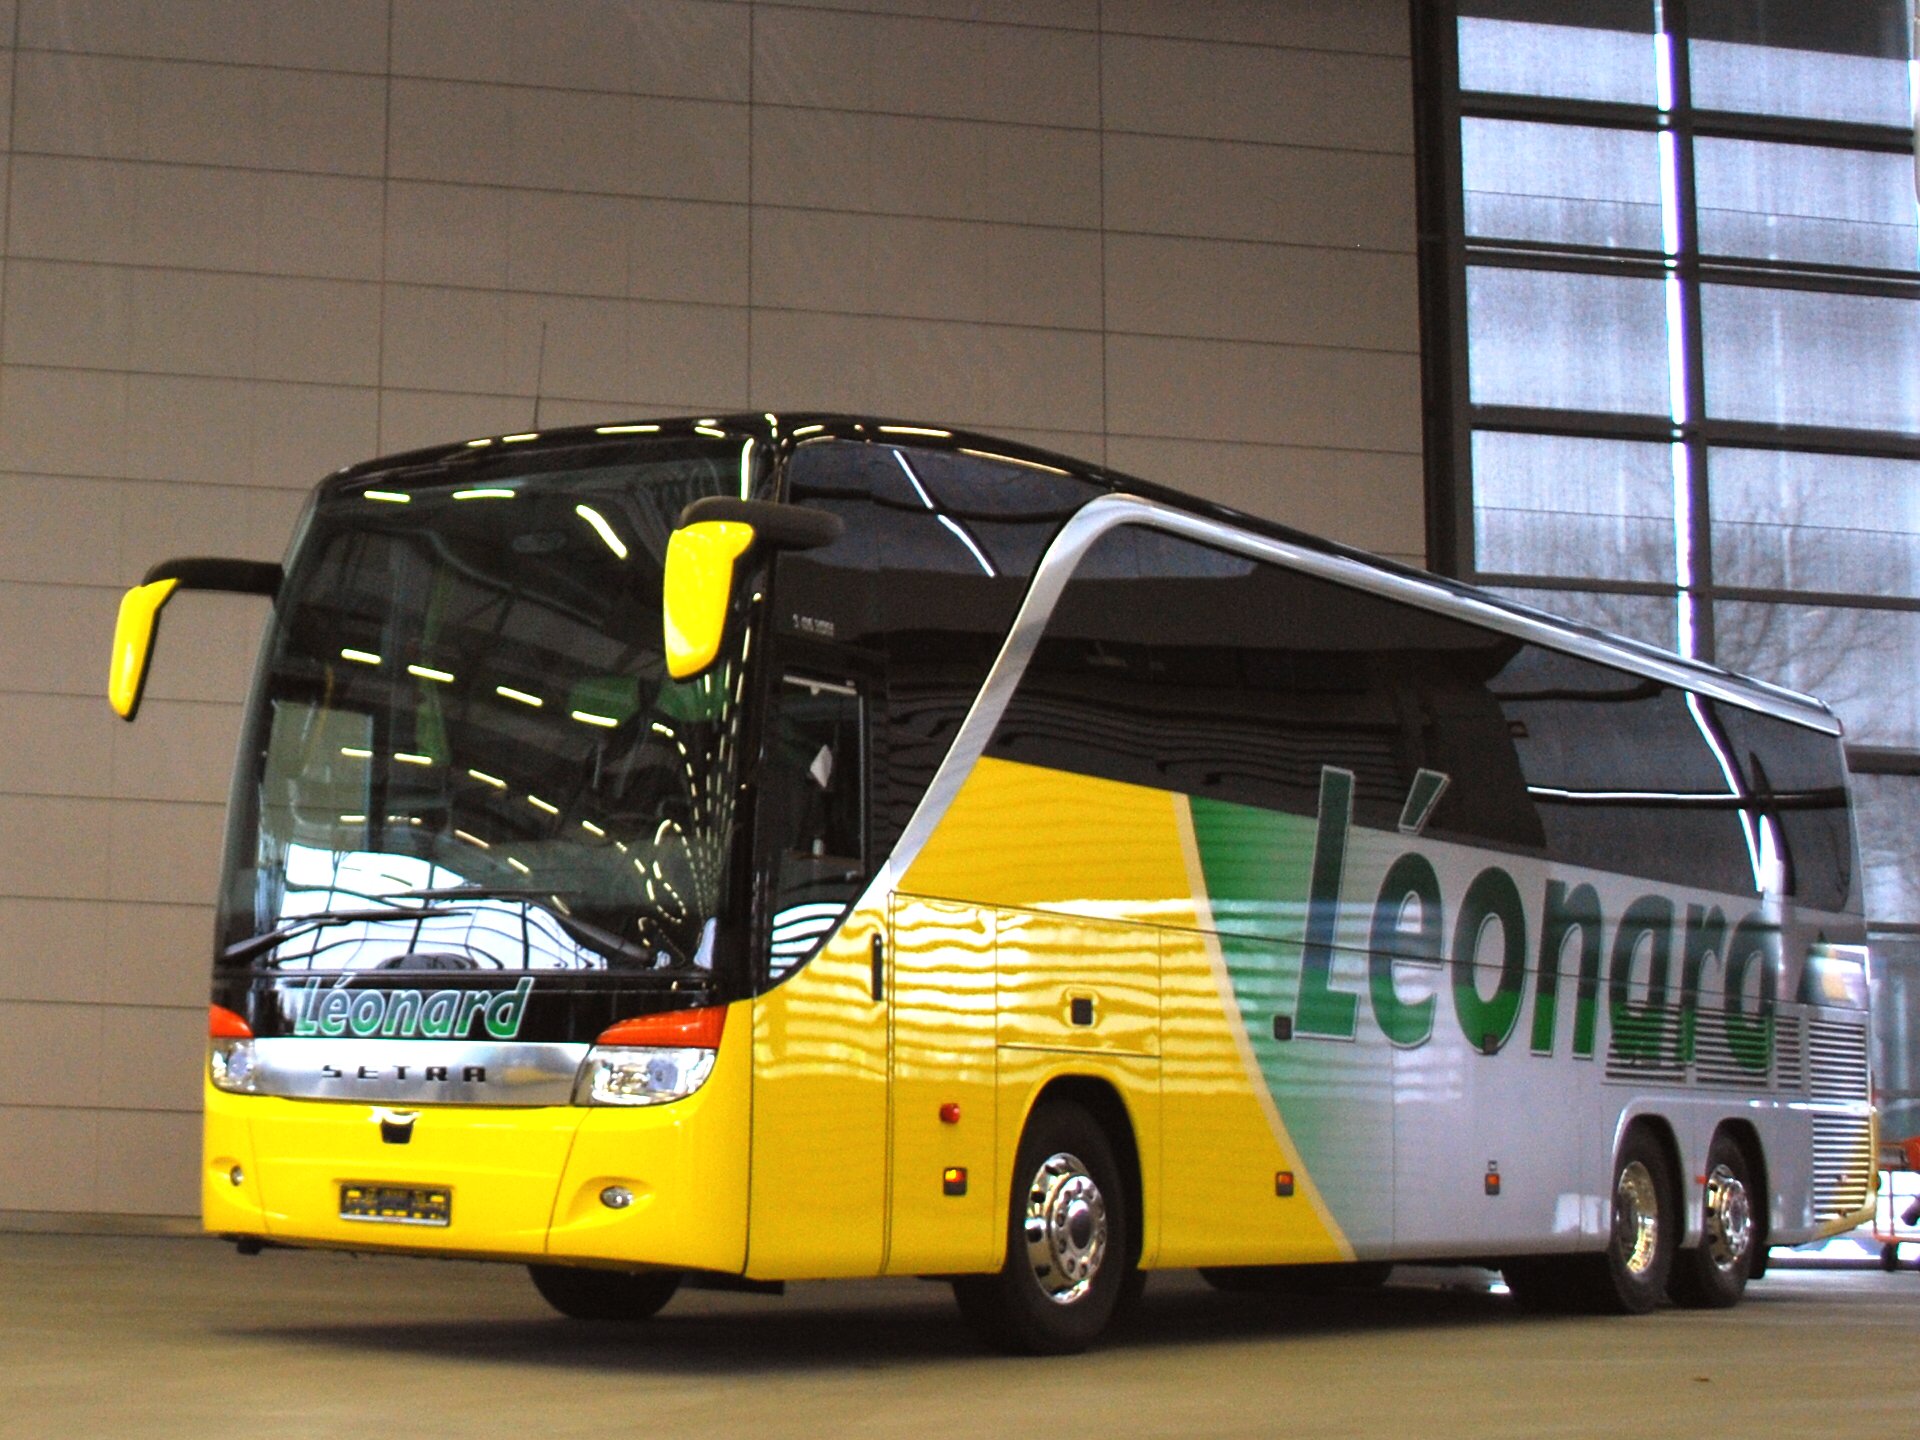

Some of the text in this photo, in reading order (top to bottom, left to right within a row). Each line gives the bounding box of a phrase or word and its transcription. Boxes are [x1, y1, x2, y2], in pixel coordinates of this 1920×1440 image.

[1294, 765, 1784, 1071] Léonard
[294, 973, 535, 1038] Léonard
[322, 1064, 486, 1082] SETRA
